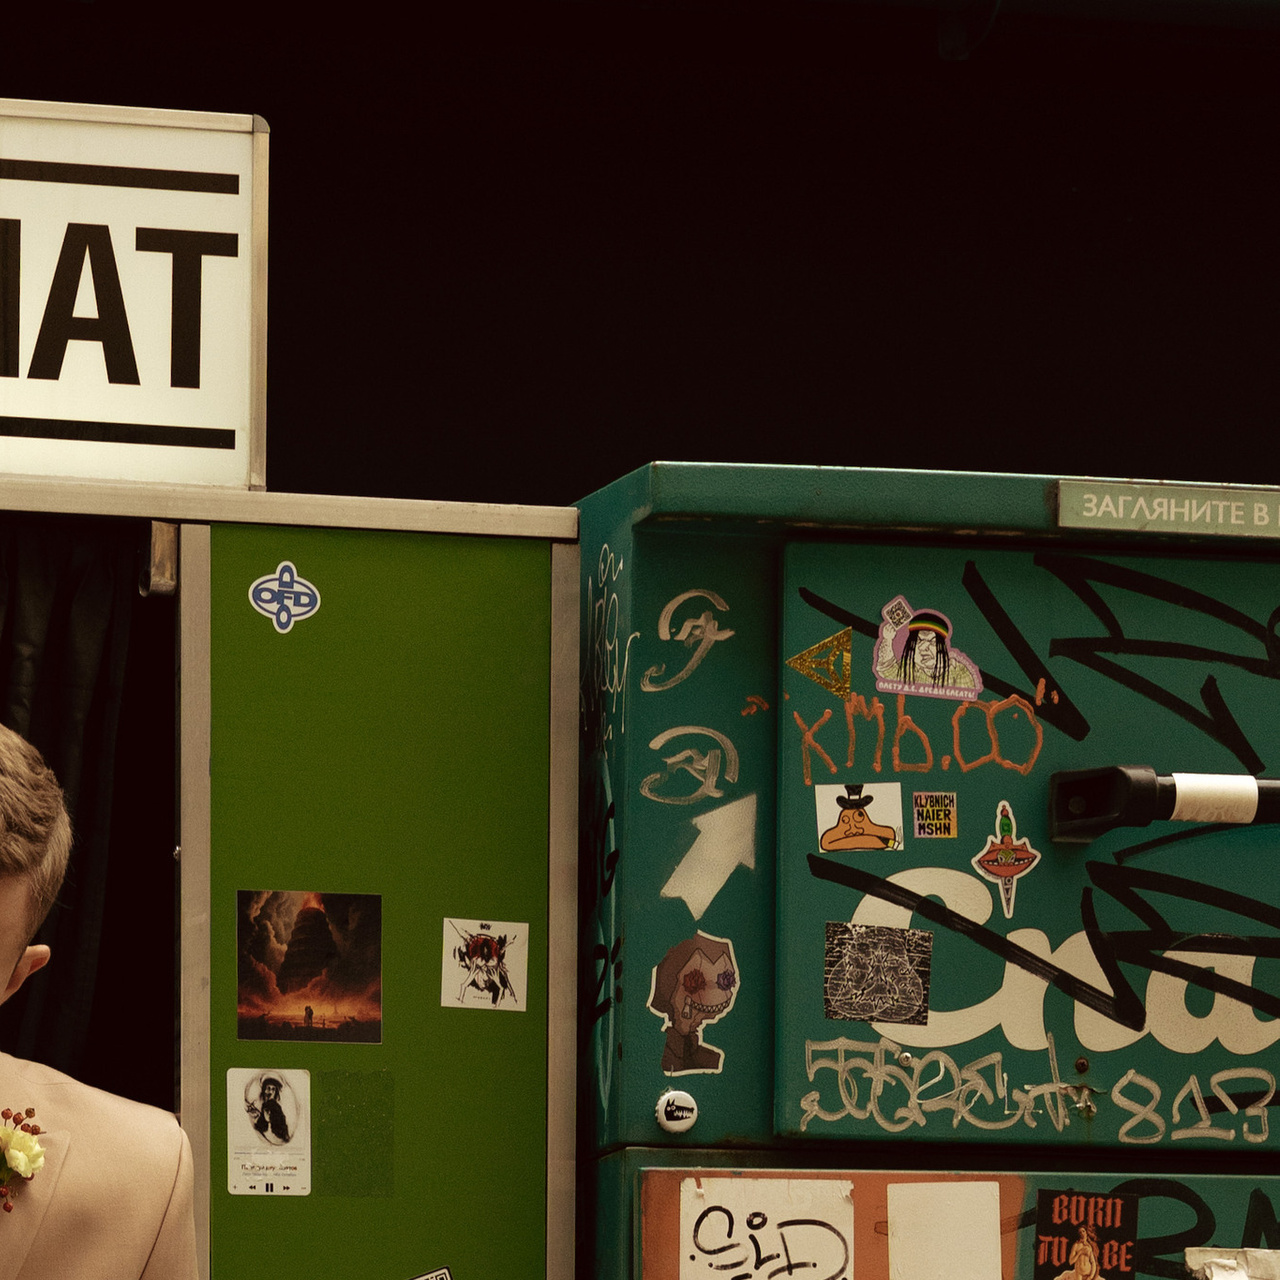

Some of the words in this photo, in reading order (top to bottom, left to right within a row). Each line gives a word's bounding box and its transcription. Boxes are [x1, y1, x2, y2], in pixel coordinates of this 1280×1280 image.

[1082, 493, 1246, 526] ЗАГЛЯНИТЕ
[1052, 1193, 1124, 1228] BORN
[1102, 1239, 1135, 1273] BE
